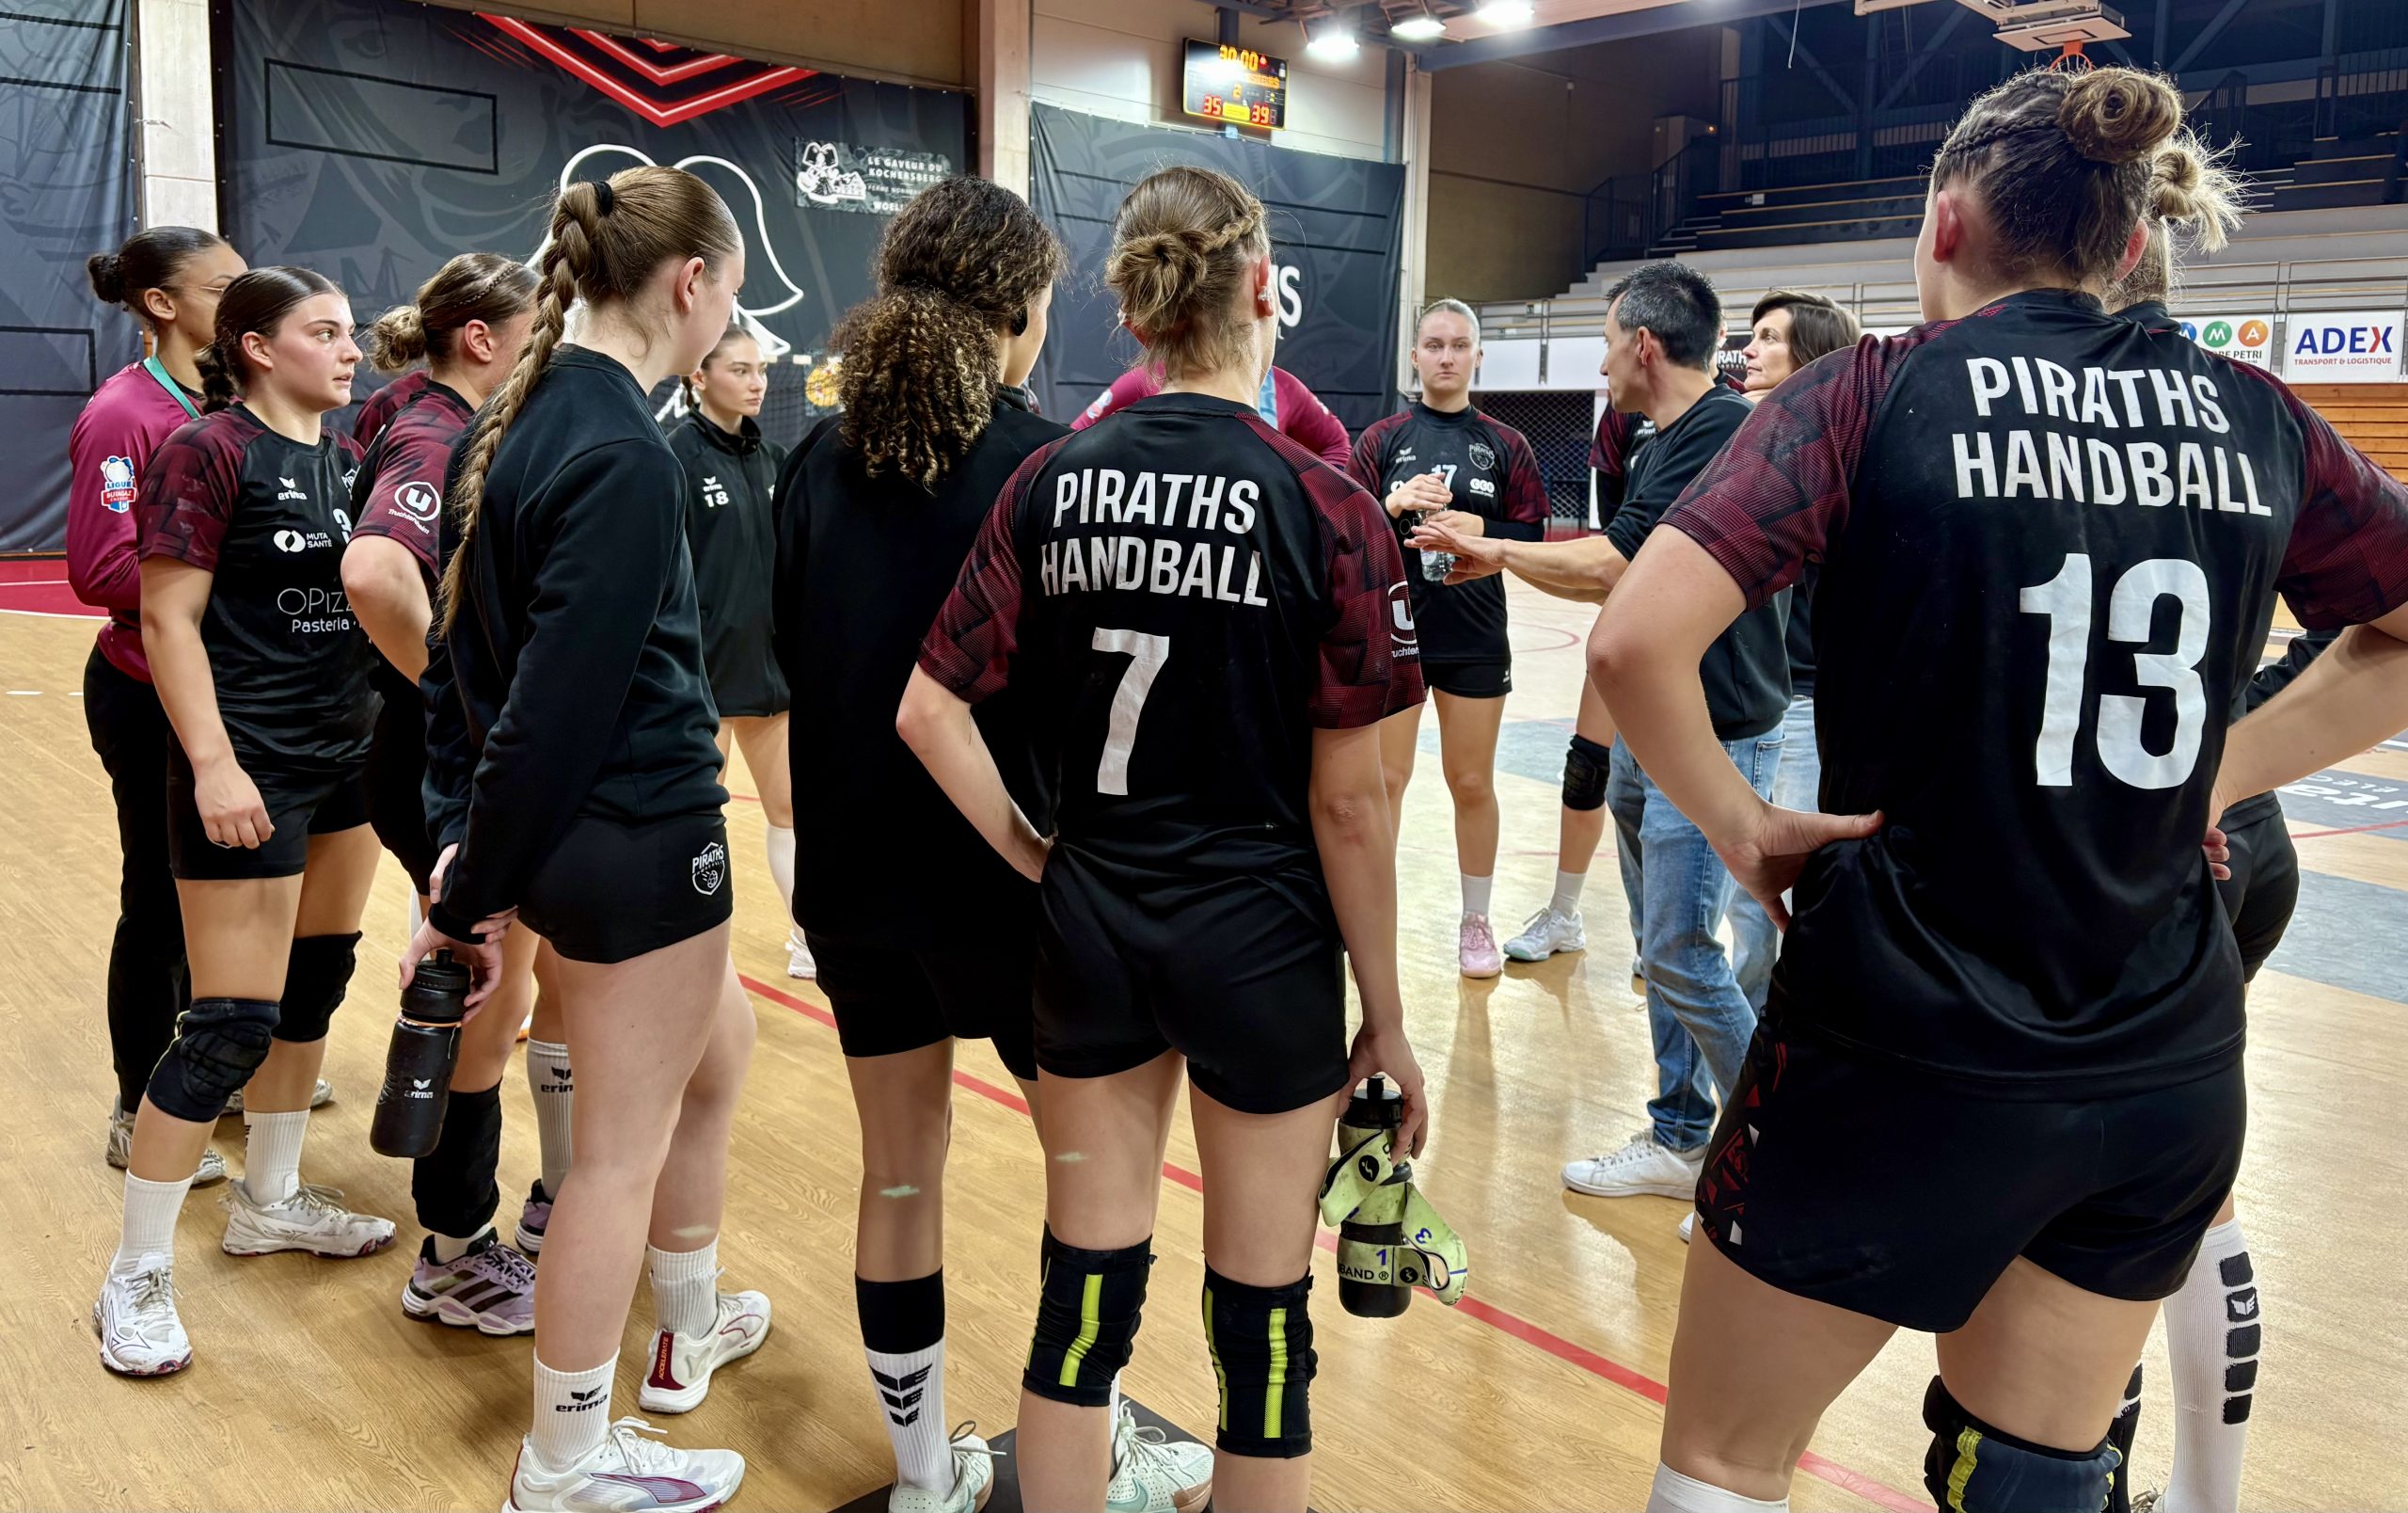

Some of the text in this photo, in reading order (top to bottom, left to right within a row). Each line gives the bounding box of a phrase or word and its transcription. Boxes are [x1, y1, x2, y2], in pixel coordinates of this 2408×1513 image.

[1204, 95, 1222, 116] 35
[1252, 103, 1270, 124] 39
[868, 156, 880, 166] LE
[928, 163, 943, 172] DU
[868, 167, 942, 183] KOCHERSBERG
[2295, 326, 2393, 355] ADEX
[1717, 349, 1747, 365] RATH
[2233, 350, 2262, 359] PETRI
[2347, 357, 2392, 365] LOGISTIQUE
[1966, 357, 2230, 434] PIRATHS
[1396, 454, 1417, 464] erima
[1952, 429, 2273, 518] HANDBALL
[106, 481, 132, 489] LIGUE
[278, 490, 308, 501] erima
[405, 487, 433, 512] U
[705, 490, 730, 508] 18
[1054, 468, 1260, 534] PIRATHS
[306, 533, 329, 541] MUTA
[307, 539, 333, 549] SANTÉ
[1041, 535, 1269, 607] HANDBALL
[292, 617, 350, 633] Pasteria
[2020, 552, 2211, 790] 13
[1091, 627, 1170, 796] 7
[692, 845, 724, 874] PIRATHS
[404, 1090, 434, 1099] erima
[1375, 1249, 1387, 1266] 1
[658, 1336, 669, 1380] ACCELERATE
[555, 1394, 608, 1412] erima
